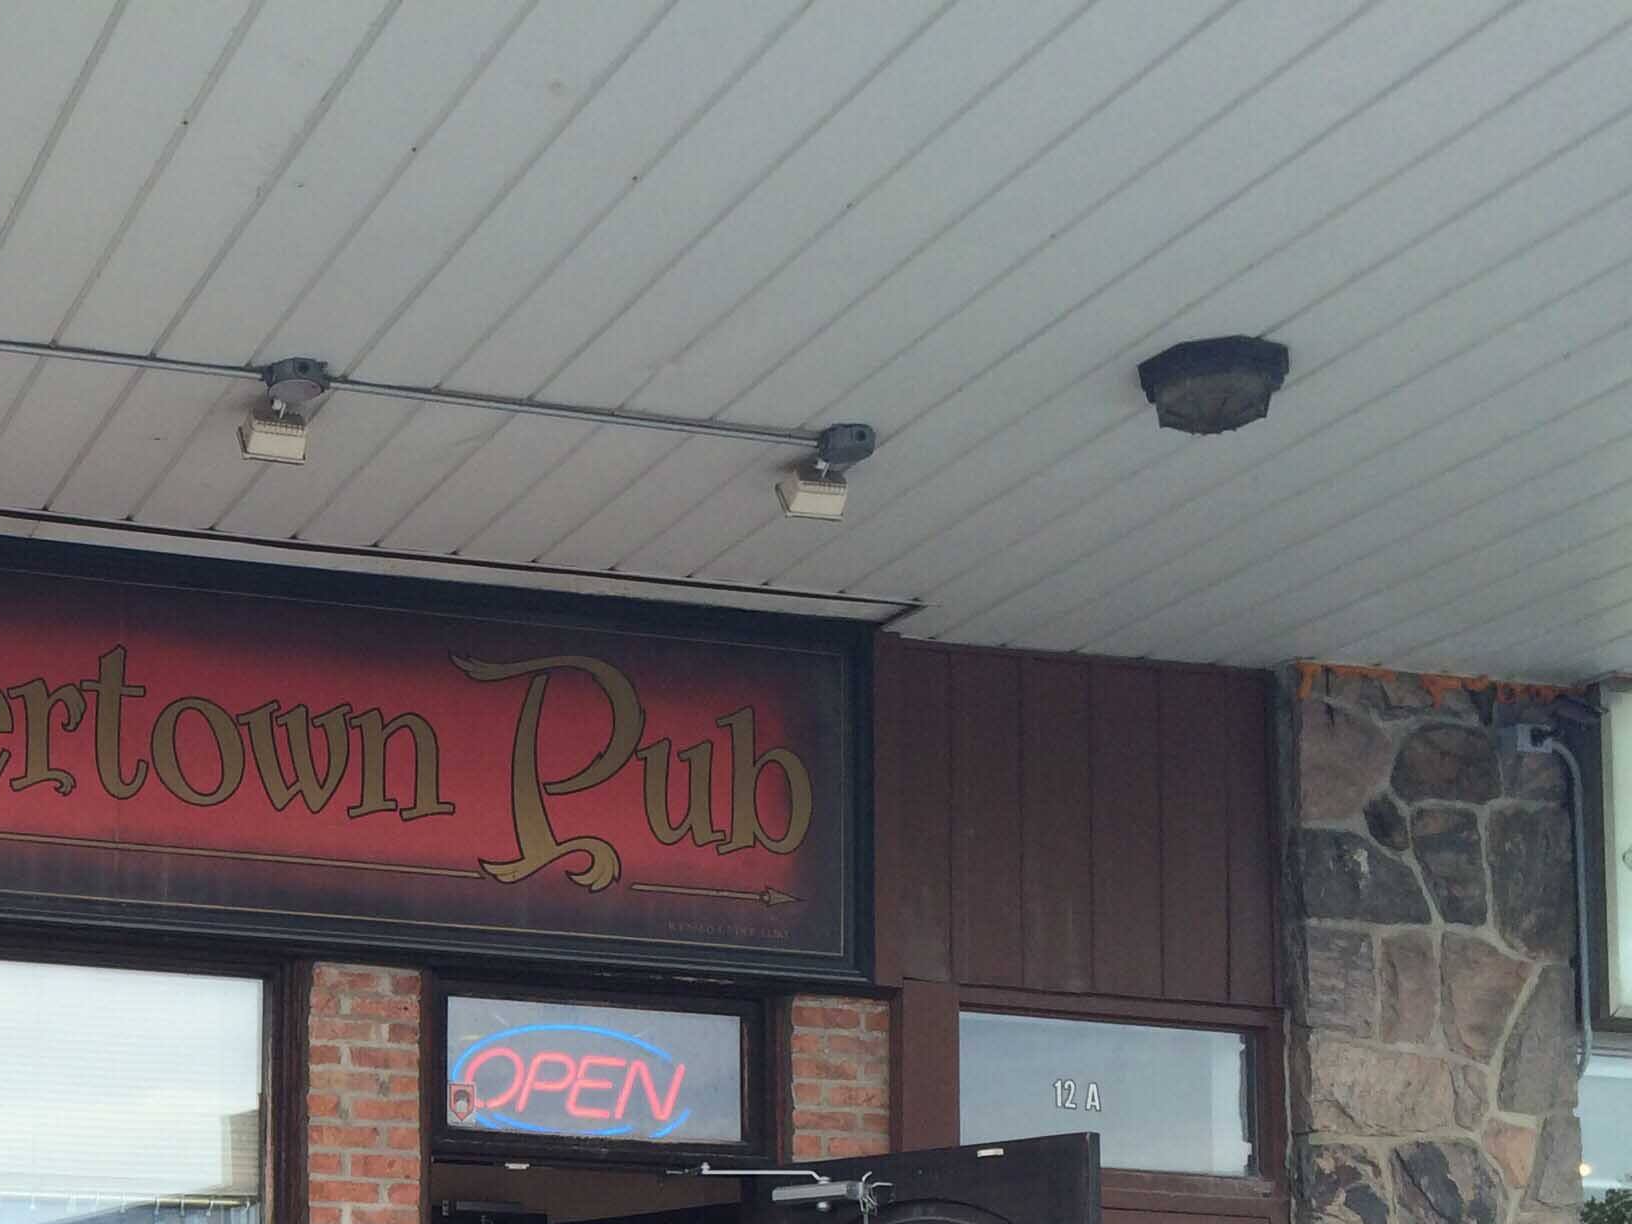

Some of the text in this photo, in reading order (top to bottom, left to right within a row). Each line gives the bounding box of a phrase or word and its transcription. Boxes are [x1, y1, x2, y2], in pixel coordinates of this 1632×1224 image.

[448, 653, 814, 893] Pub
[464, 1046, 687, 1122] OPEN
[1052, 1078, 1102, 1112] 12 A
